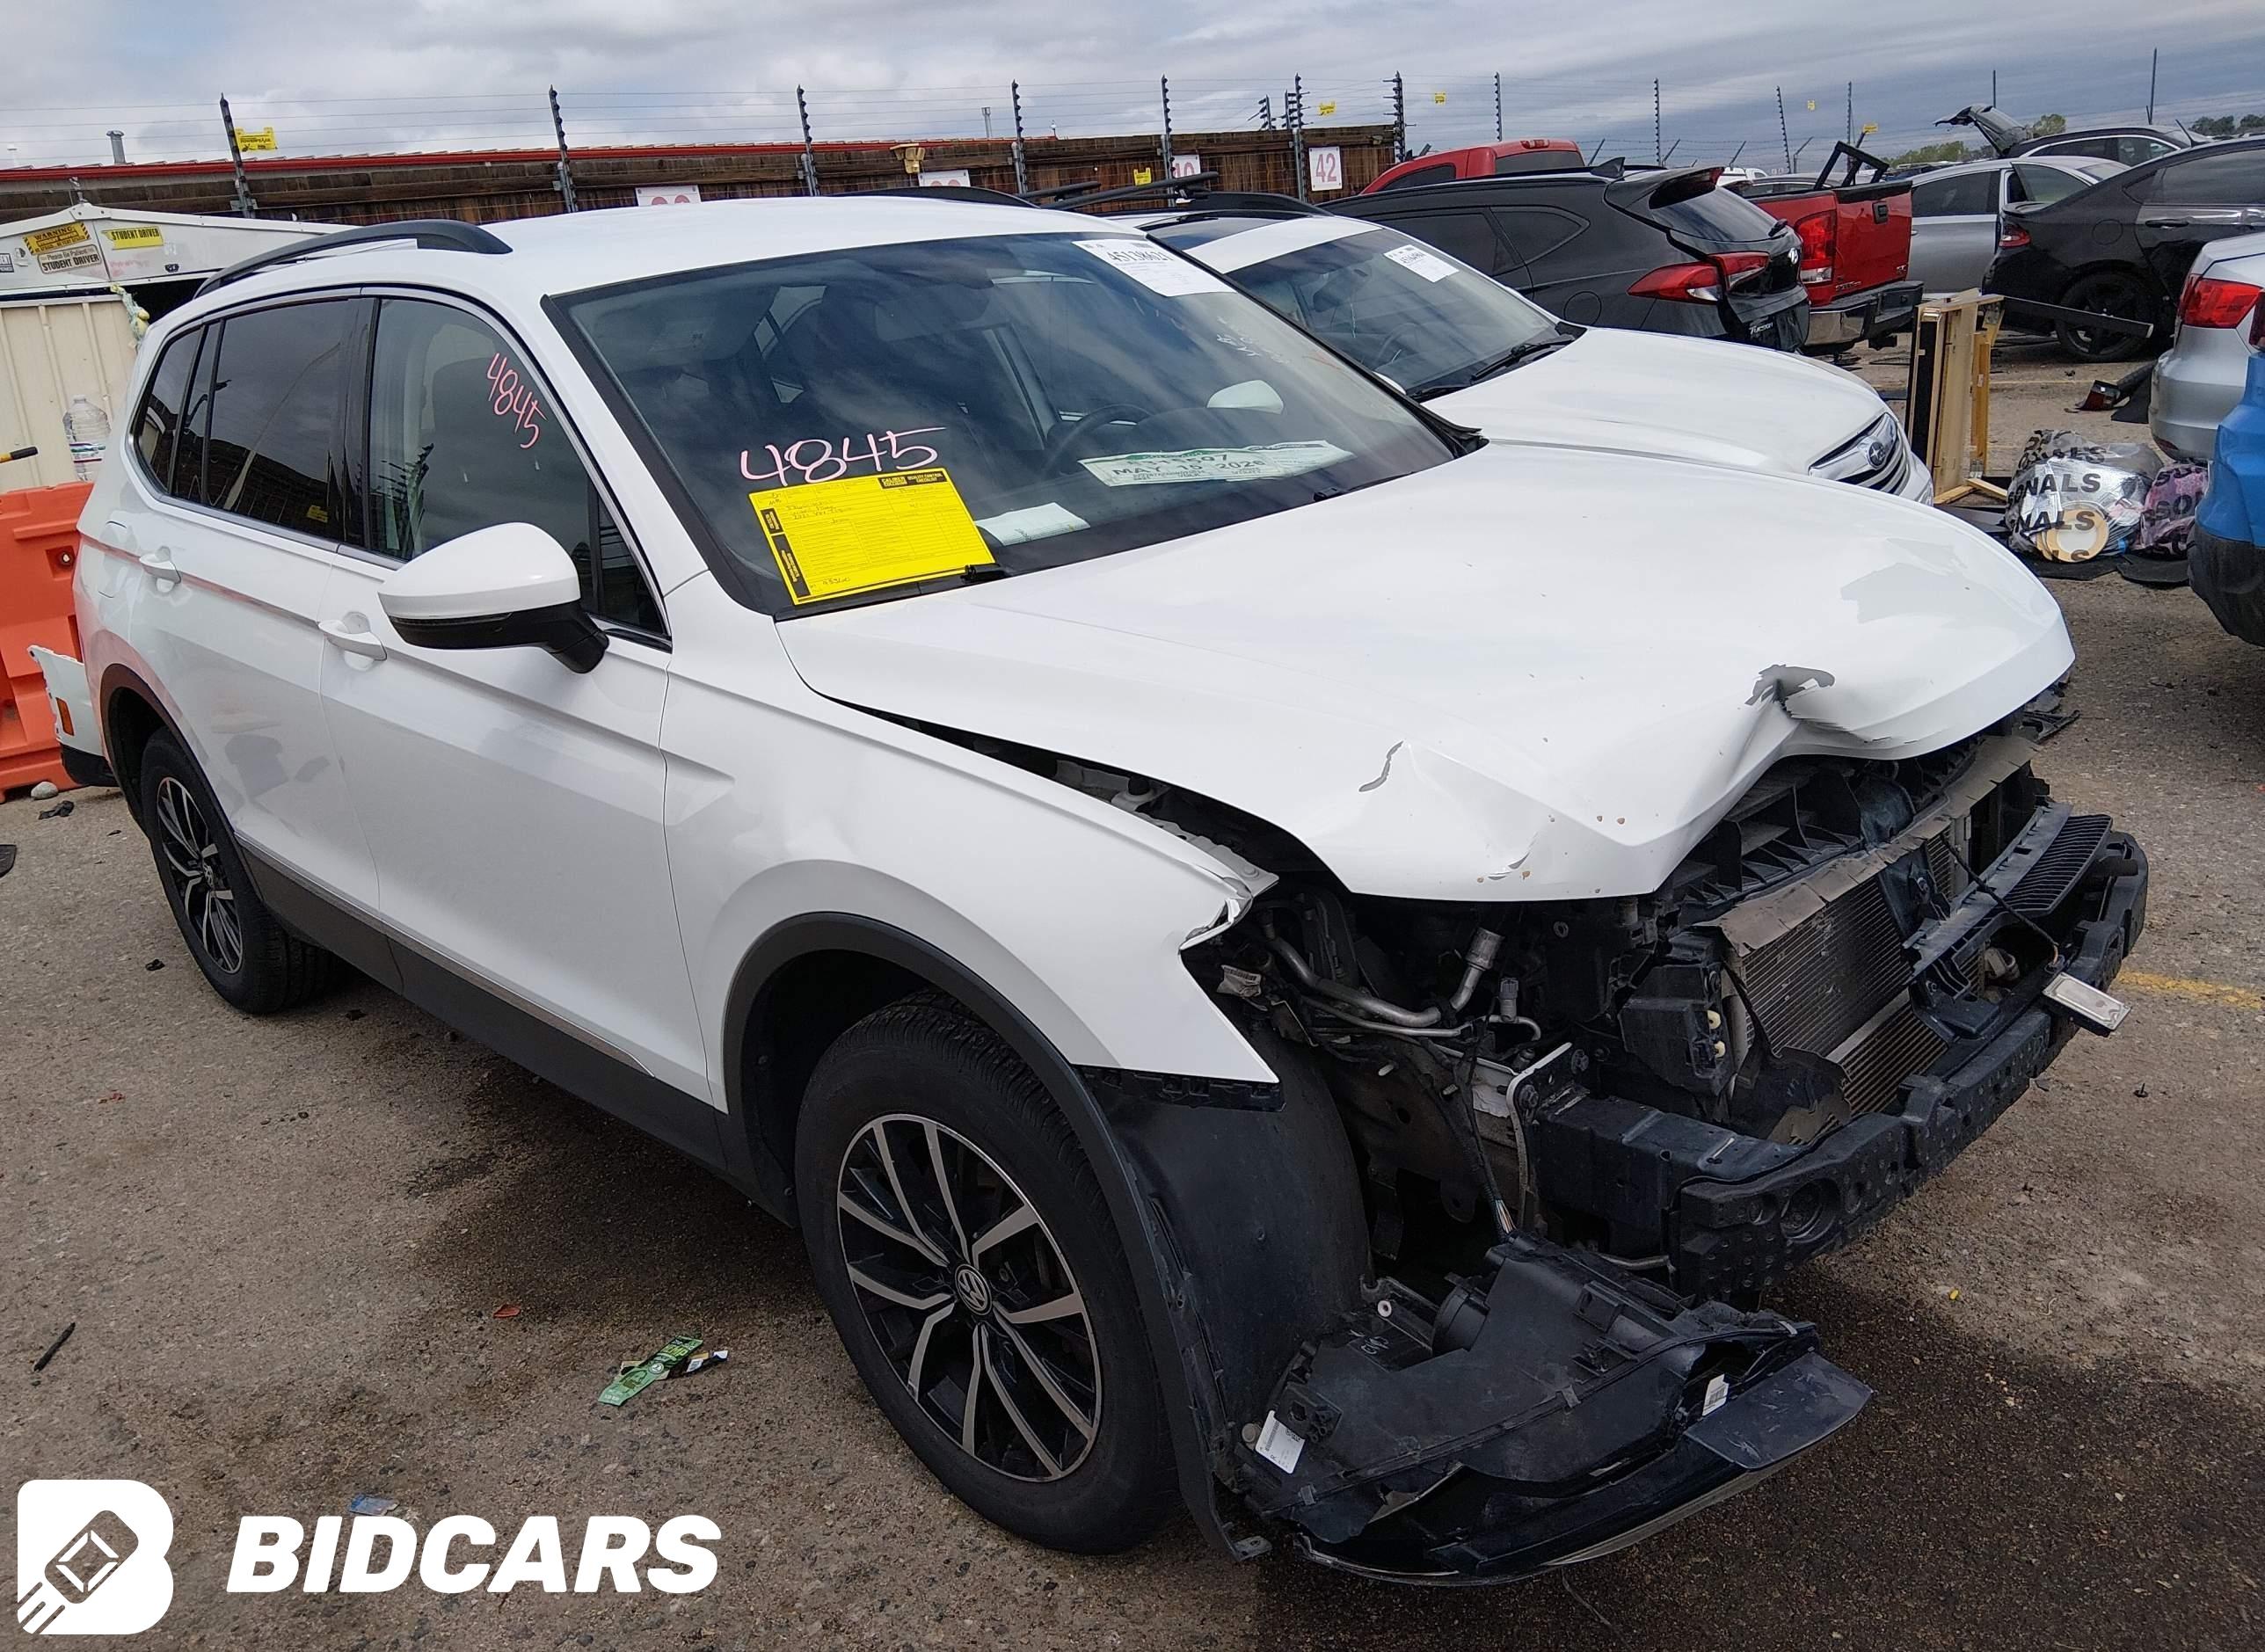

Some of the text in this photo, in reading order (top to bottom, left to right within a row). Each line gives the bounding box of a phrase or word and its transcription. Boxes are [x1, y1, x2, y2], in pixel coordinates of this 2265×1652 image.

[1316, 153, 1337, 182] 42
[35, 226, 73, 240] WARNING
[111, 228, 160, 241] STUDENT DRIVER
[42, 253, 100, 272] STUDENT DRIVER
[487, 353, 547, 448] 4845
[740, 426, 947, 486] 4845
[1112, 465, 1162, 476] MAY
